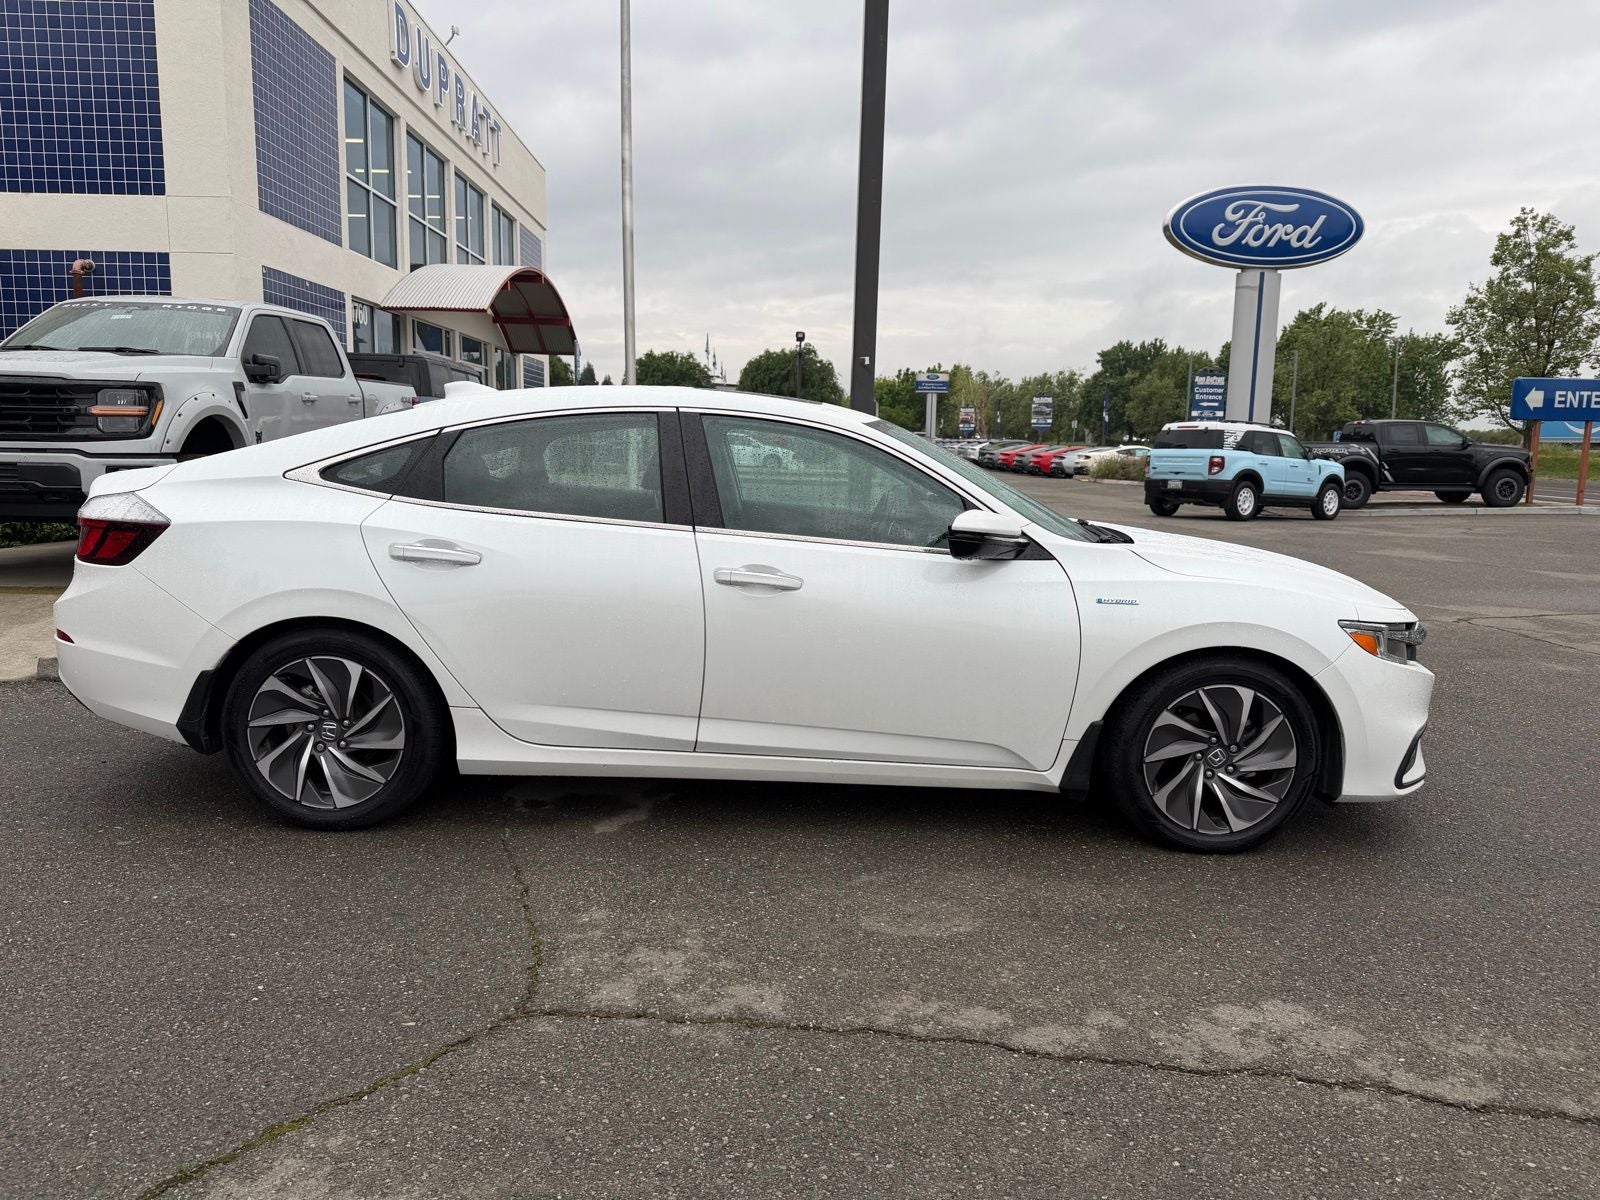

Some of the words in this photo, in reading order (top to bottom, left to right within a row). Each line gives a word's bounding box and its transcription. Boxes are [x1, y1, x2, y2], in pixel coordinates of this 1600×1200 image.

[391, 0, 502, 167] DUPRATT
[1212, 200, 1327, 248] Ford
[162, 304, 226, 312] RIDGE
[1554, 390, 1600, 408] ENTE
